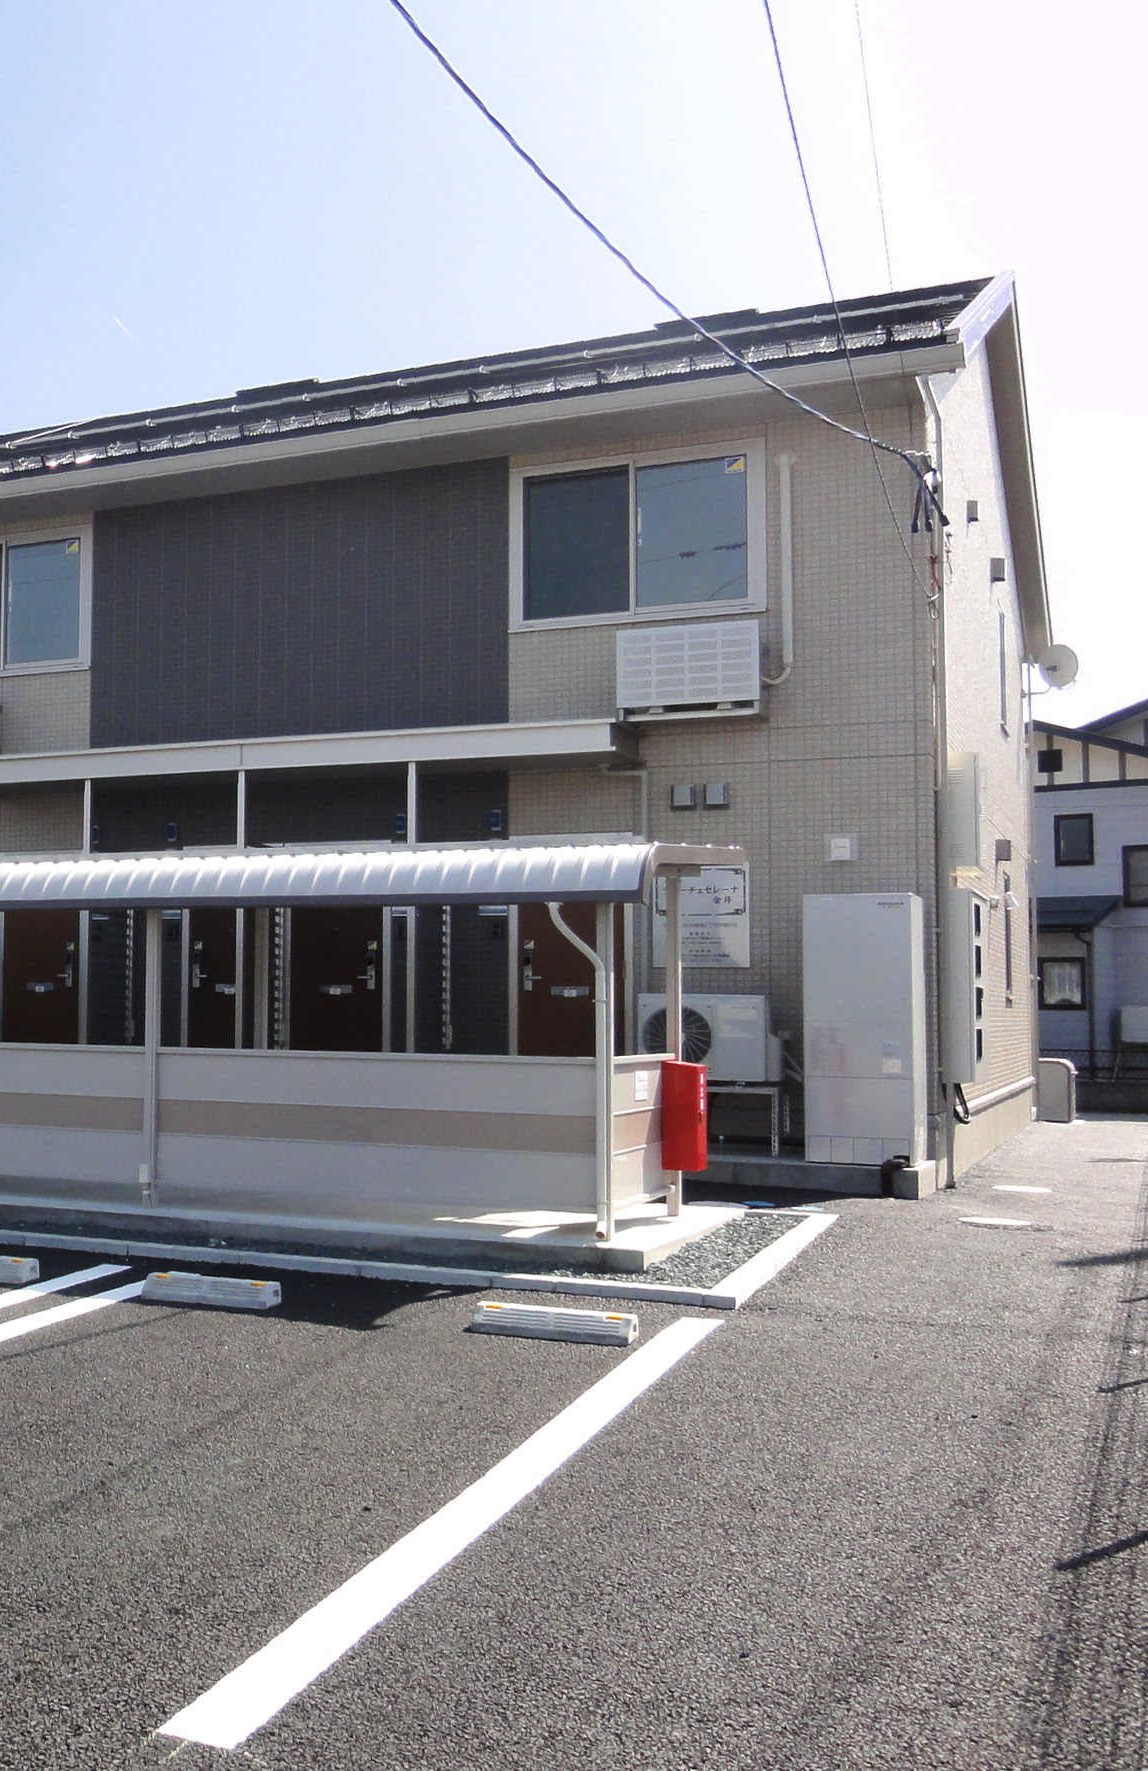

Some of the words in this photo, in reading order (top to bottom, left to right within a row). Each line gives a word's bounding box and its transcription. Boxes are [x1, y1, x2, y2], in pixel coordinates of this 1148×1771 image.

[662, 885, 739, 895] ーチェセレーナ
